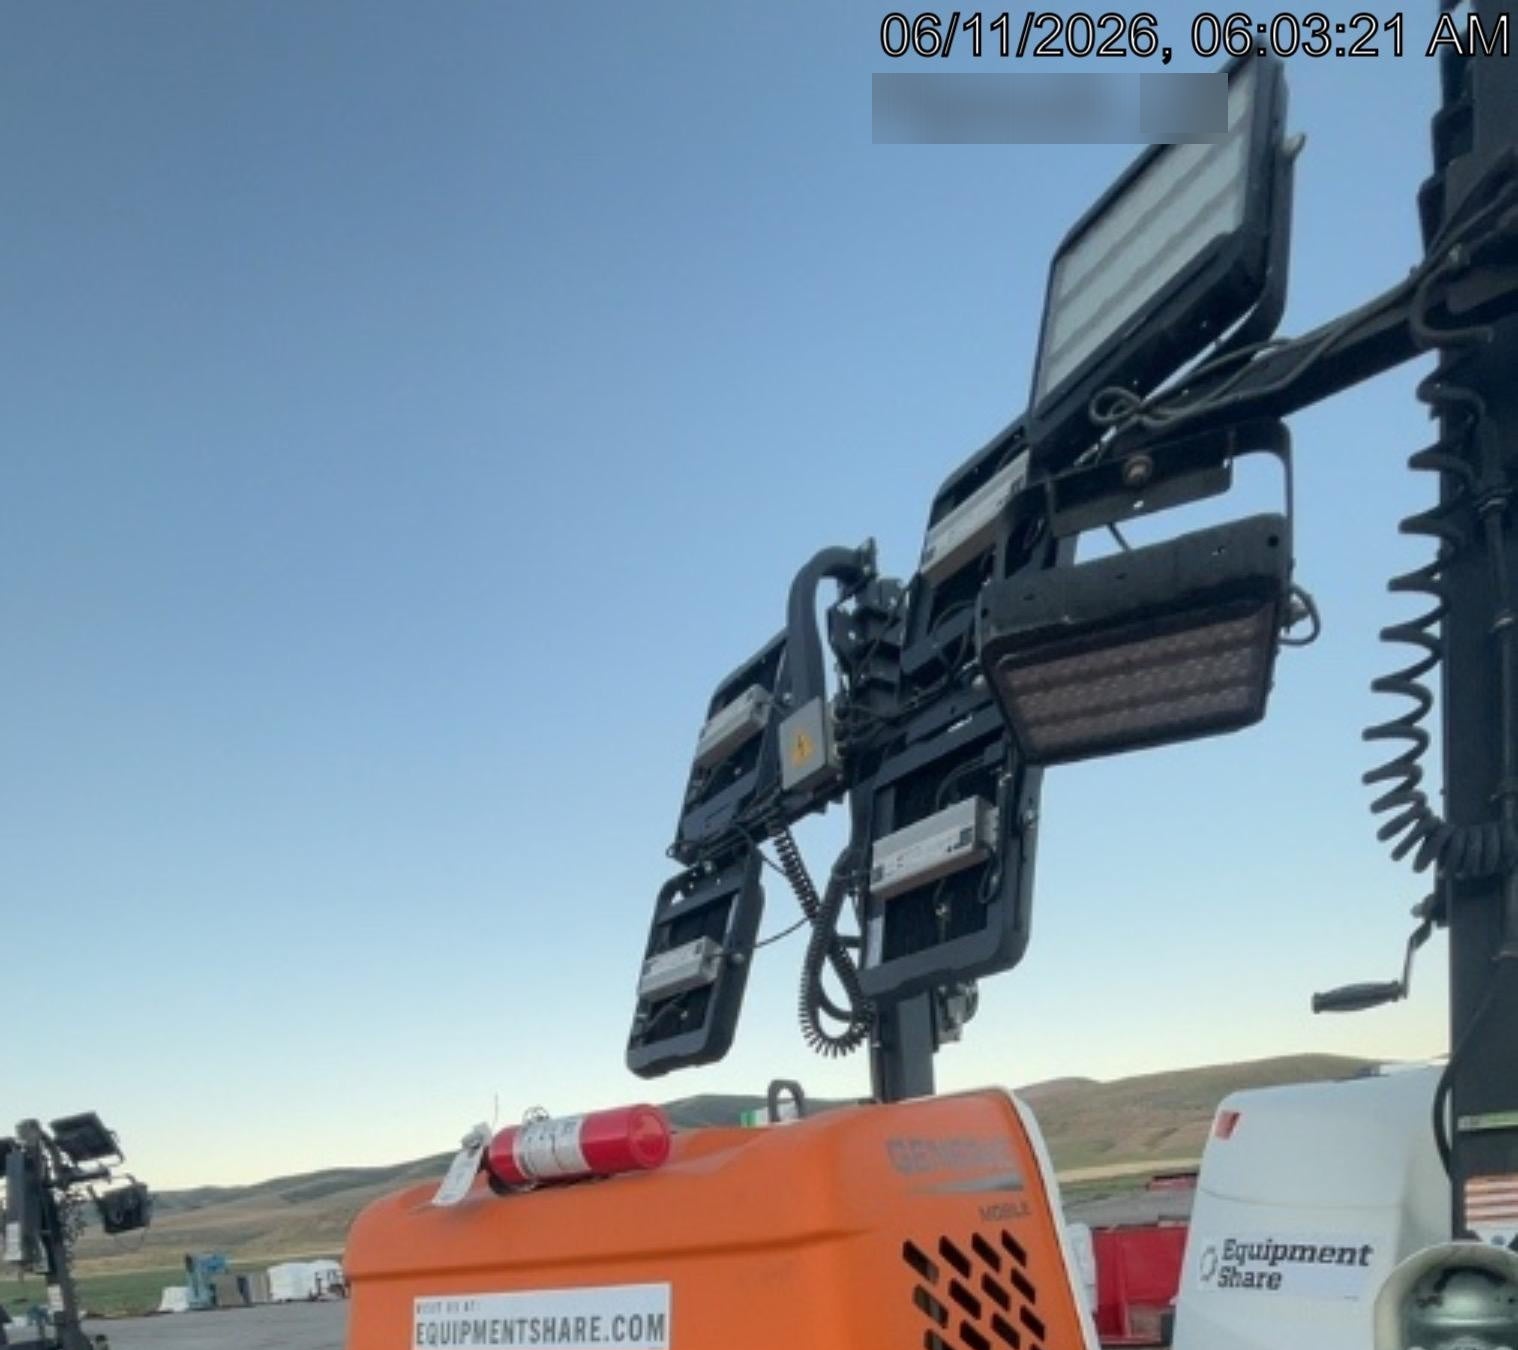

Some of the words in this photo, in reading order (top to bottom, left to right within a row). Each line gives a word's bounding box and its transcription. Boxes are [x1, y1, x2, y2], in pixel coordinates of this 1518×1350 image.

[1222, 1237, 1374, 1267] Equipment
[1217, 1265, 1283, 1291] Share
[416, 1312, 666, 1346] EQUIPMENTSHARE.COM
